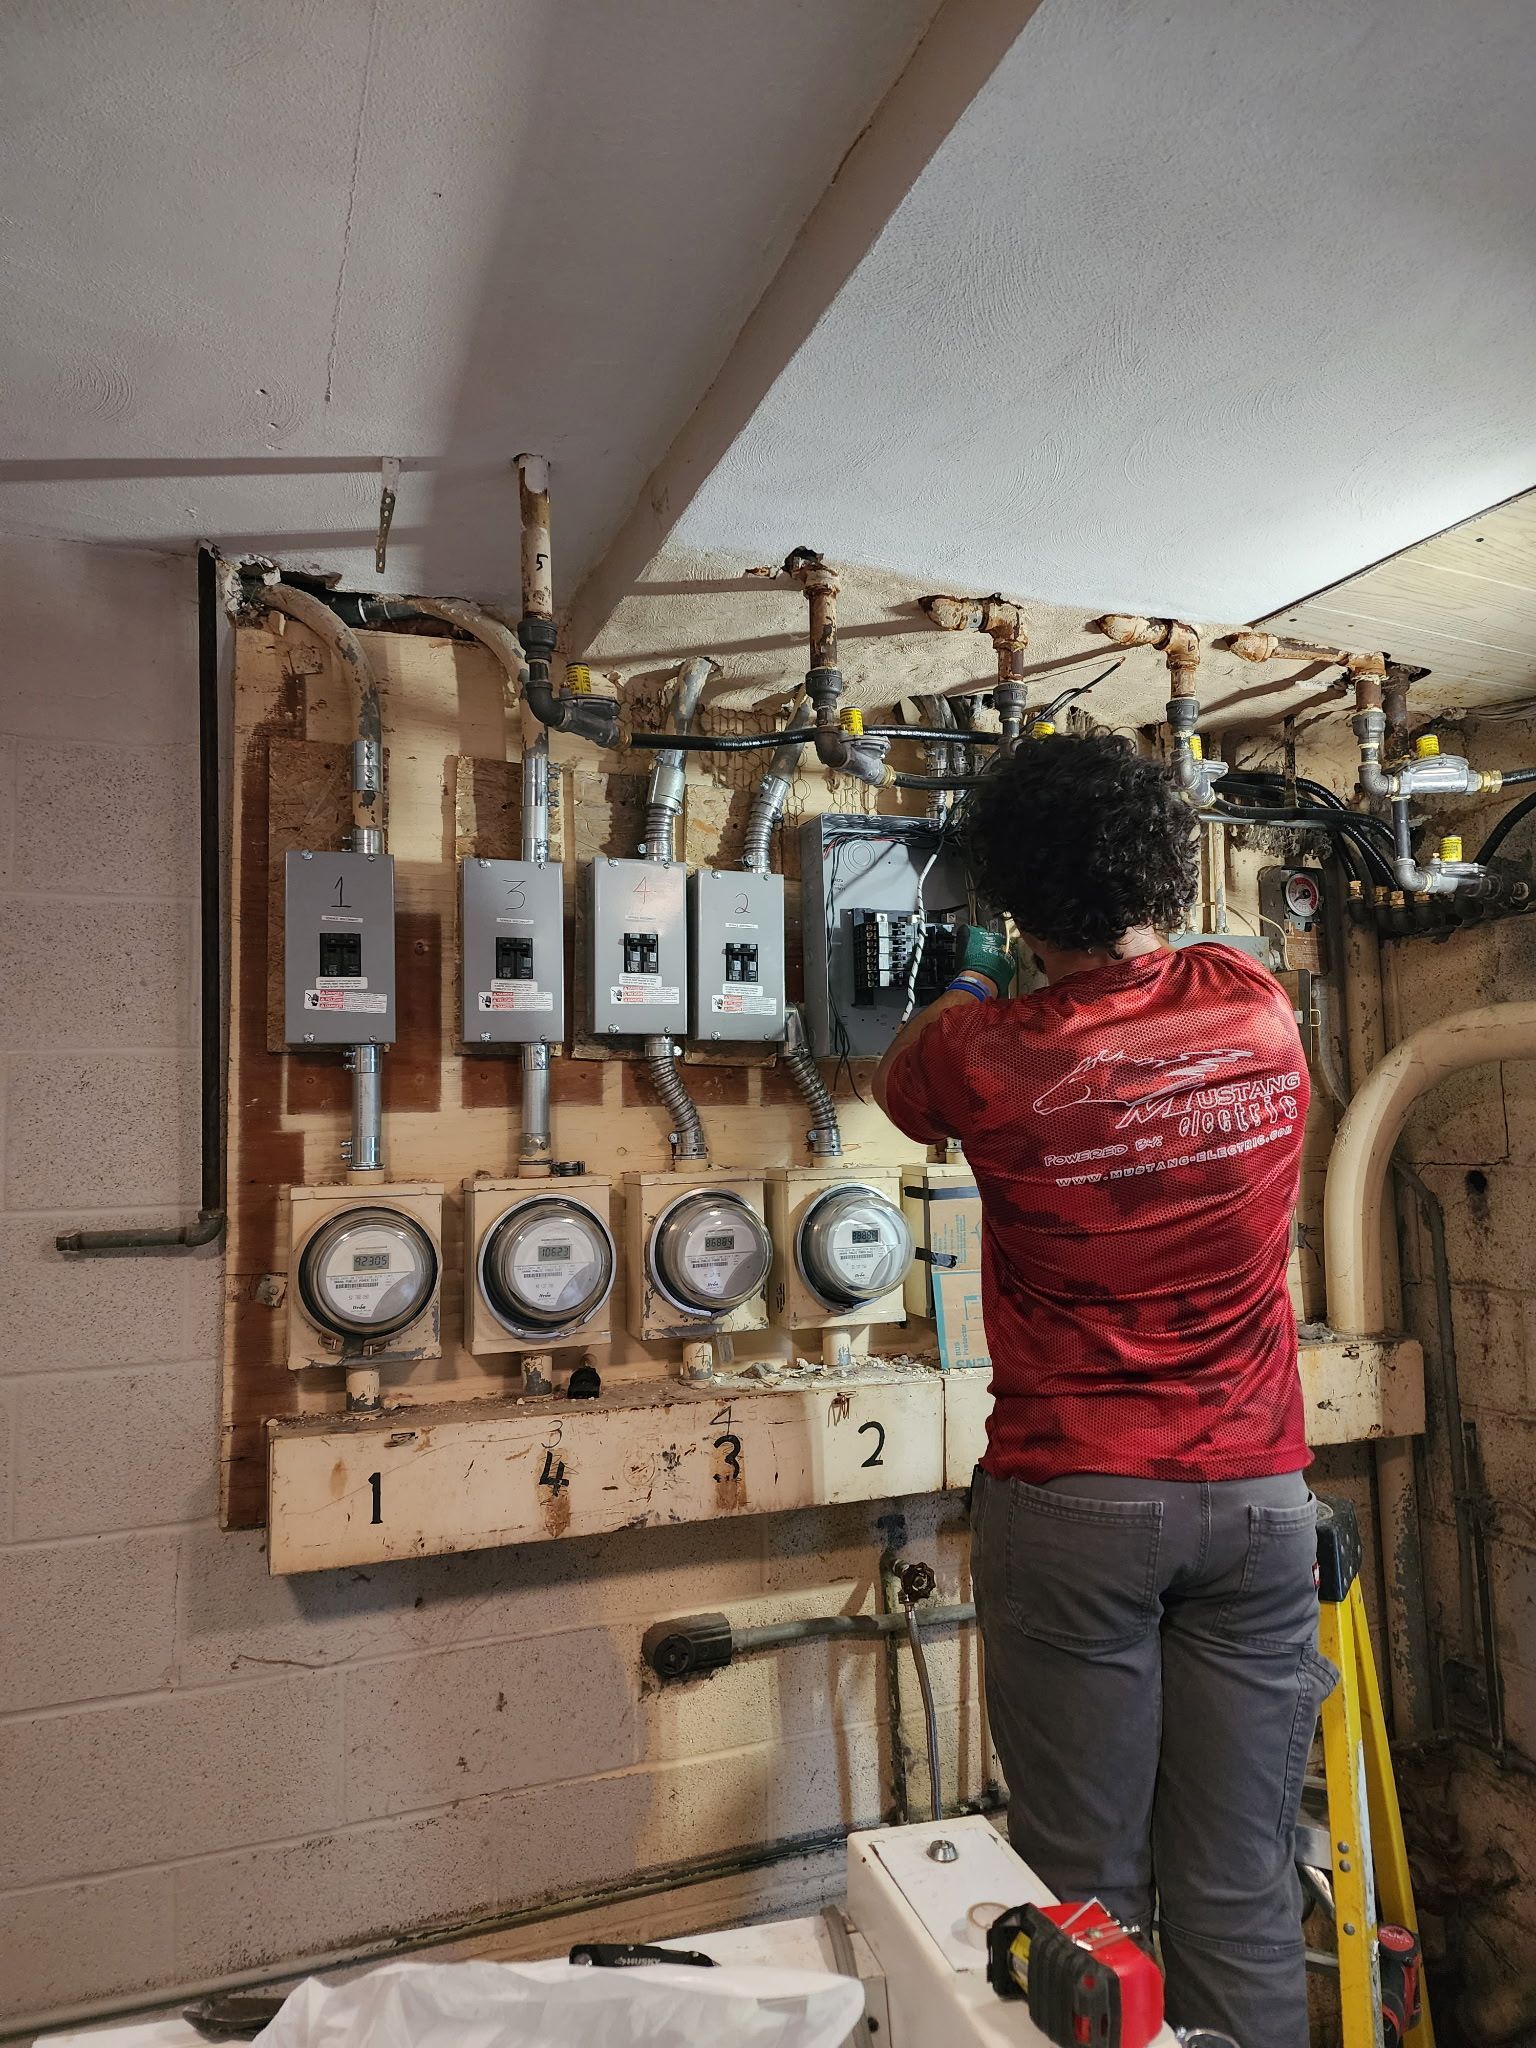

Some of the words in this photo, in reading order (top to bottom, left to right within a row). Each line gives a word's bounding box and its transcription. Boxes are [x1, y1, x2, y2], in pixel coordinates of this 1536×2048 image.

[535, 553, 549, 571] 5
[329, 875, 352, 908] 1
[502, 879, 527, 911] 3
[632, 876, 657, 904] 4
[734, 892, 751, 914] 2
[1115, 1071, 1300, 1130] MUSTANG
[1178, 1095, 1298, 1138] electric
[540, 1419, 564, 1449] 3
[708, 1405, 743, 1436] 4
[712, 1434, 742, 1482] 3
[857, 1420, 886, 1468] 2
[539, 1450, 570, 1497] 4
[367, 1471, 384, 1525] 1
